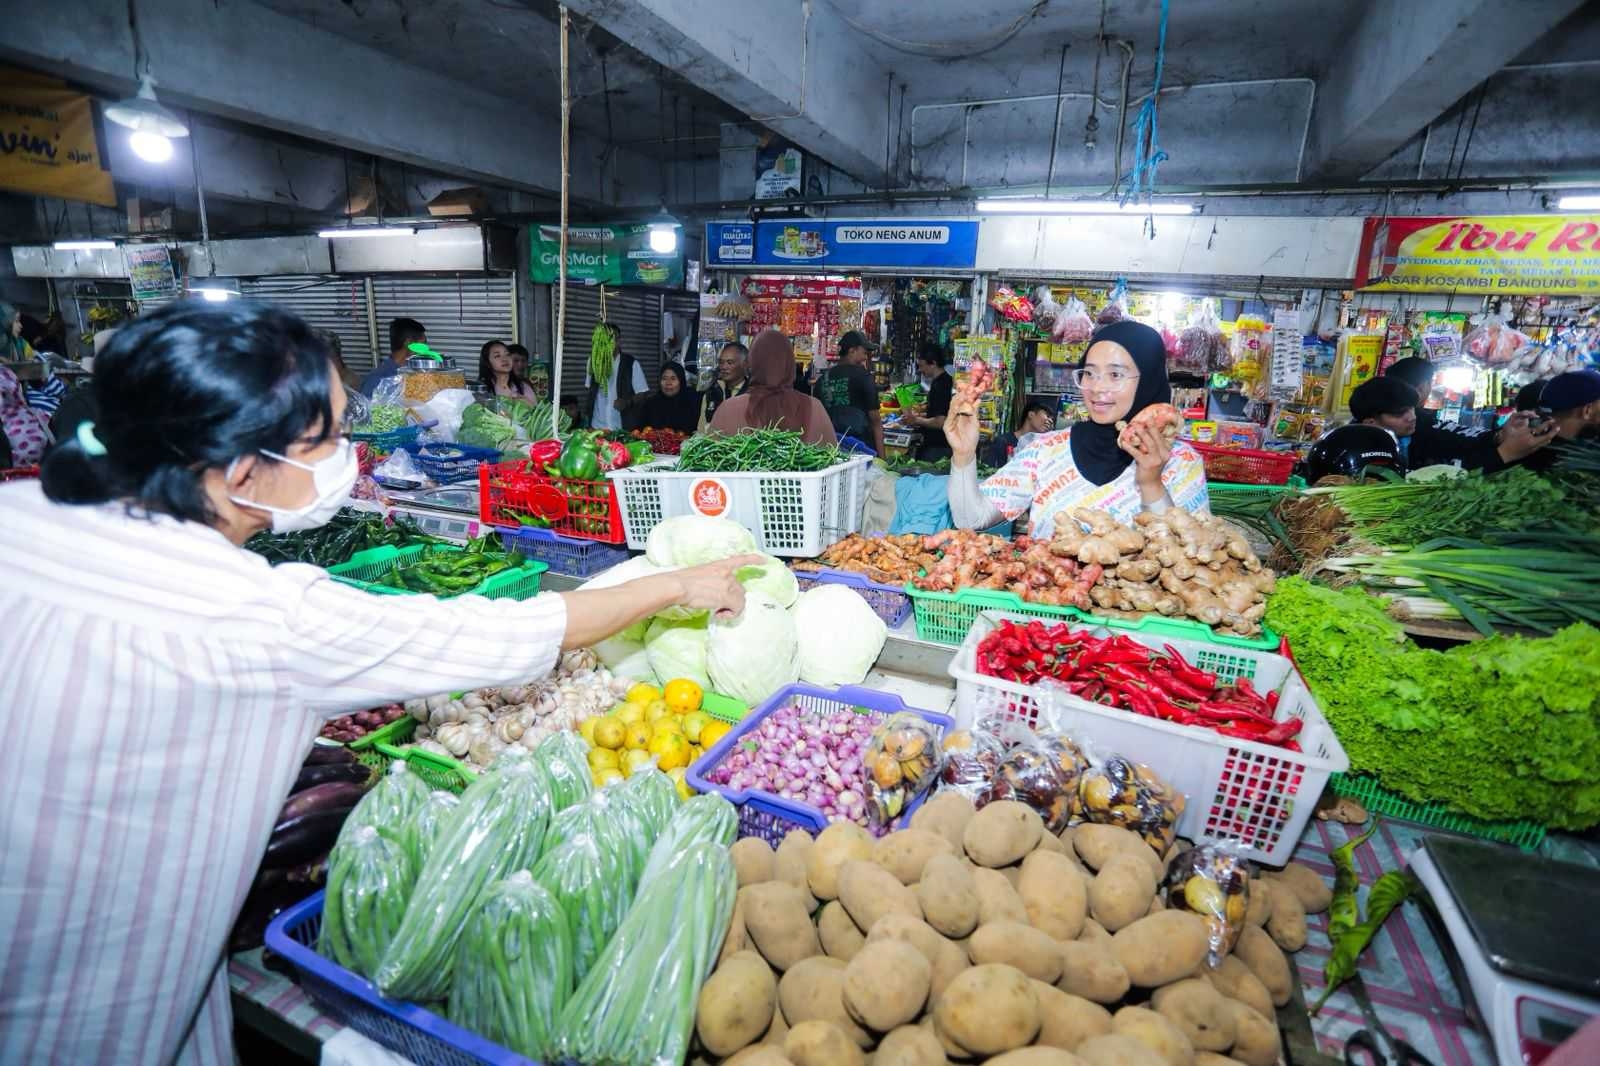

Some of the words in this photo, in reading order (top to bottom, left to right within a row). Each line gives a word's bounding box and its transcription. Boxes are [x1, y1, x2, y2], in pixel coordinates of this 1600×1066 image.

[843, 229, 873, 240] TOKO
[875, 229, 906, 240] NENG
[908, 229, 942, 240] ANUM
[1434, 223, 1537, 252] Ibu
[1380, 274, 1421, 285] ASAR
[1424, 275, 1494, 287] KOSAMBI
[1498, 278, 1577, 288] BANDUNG
